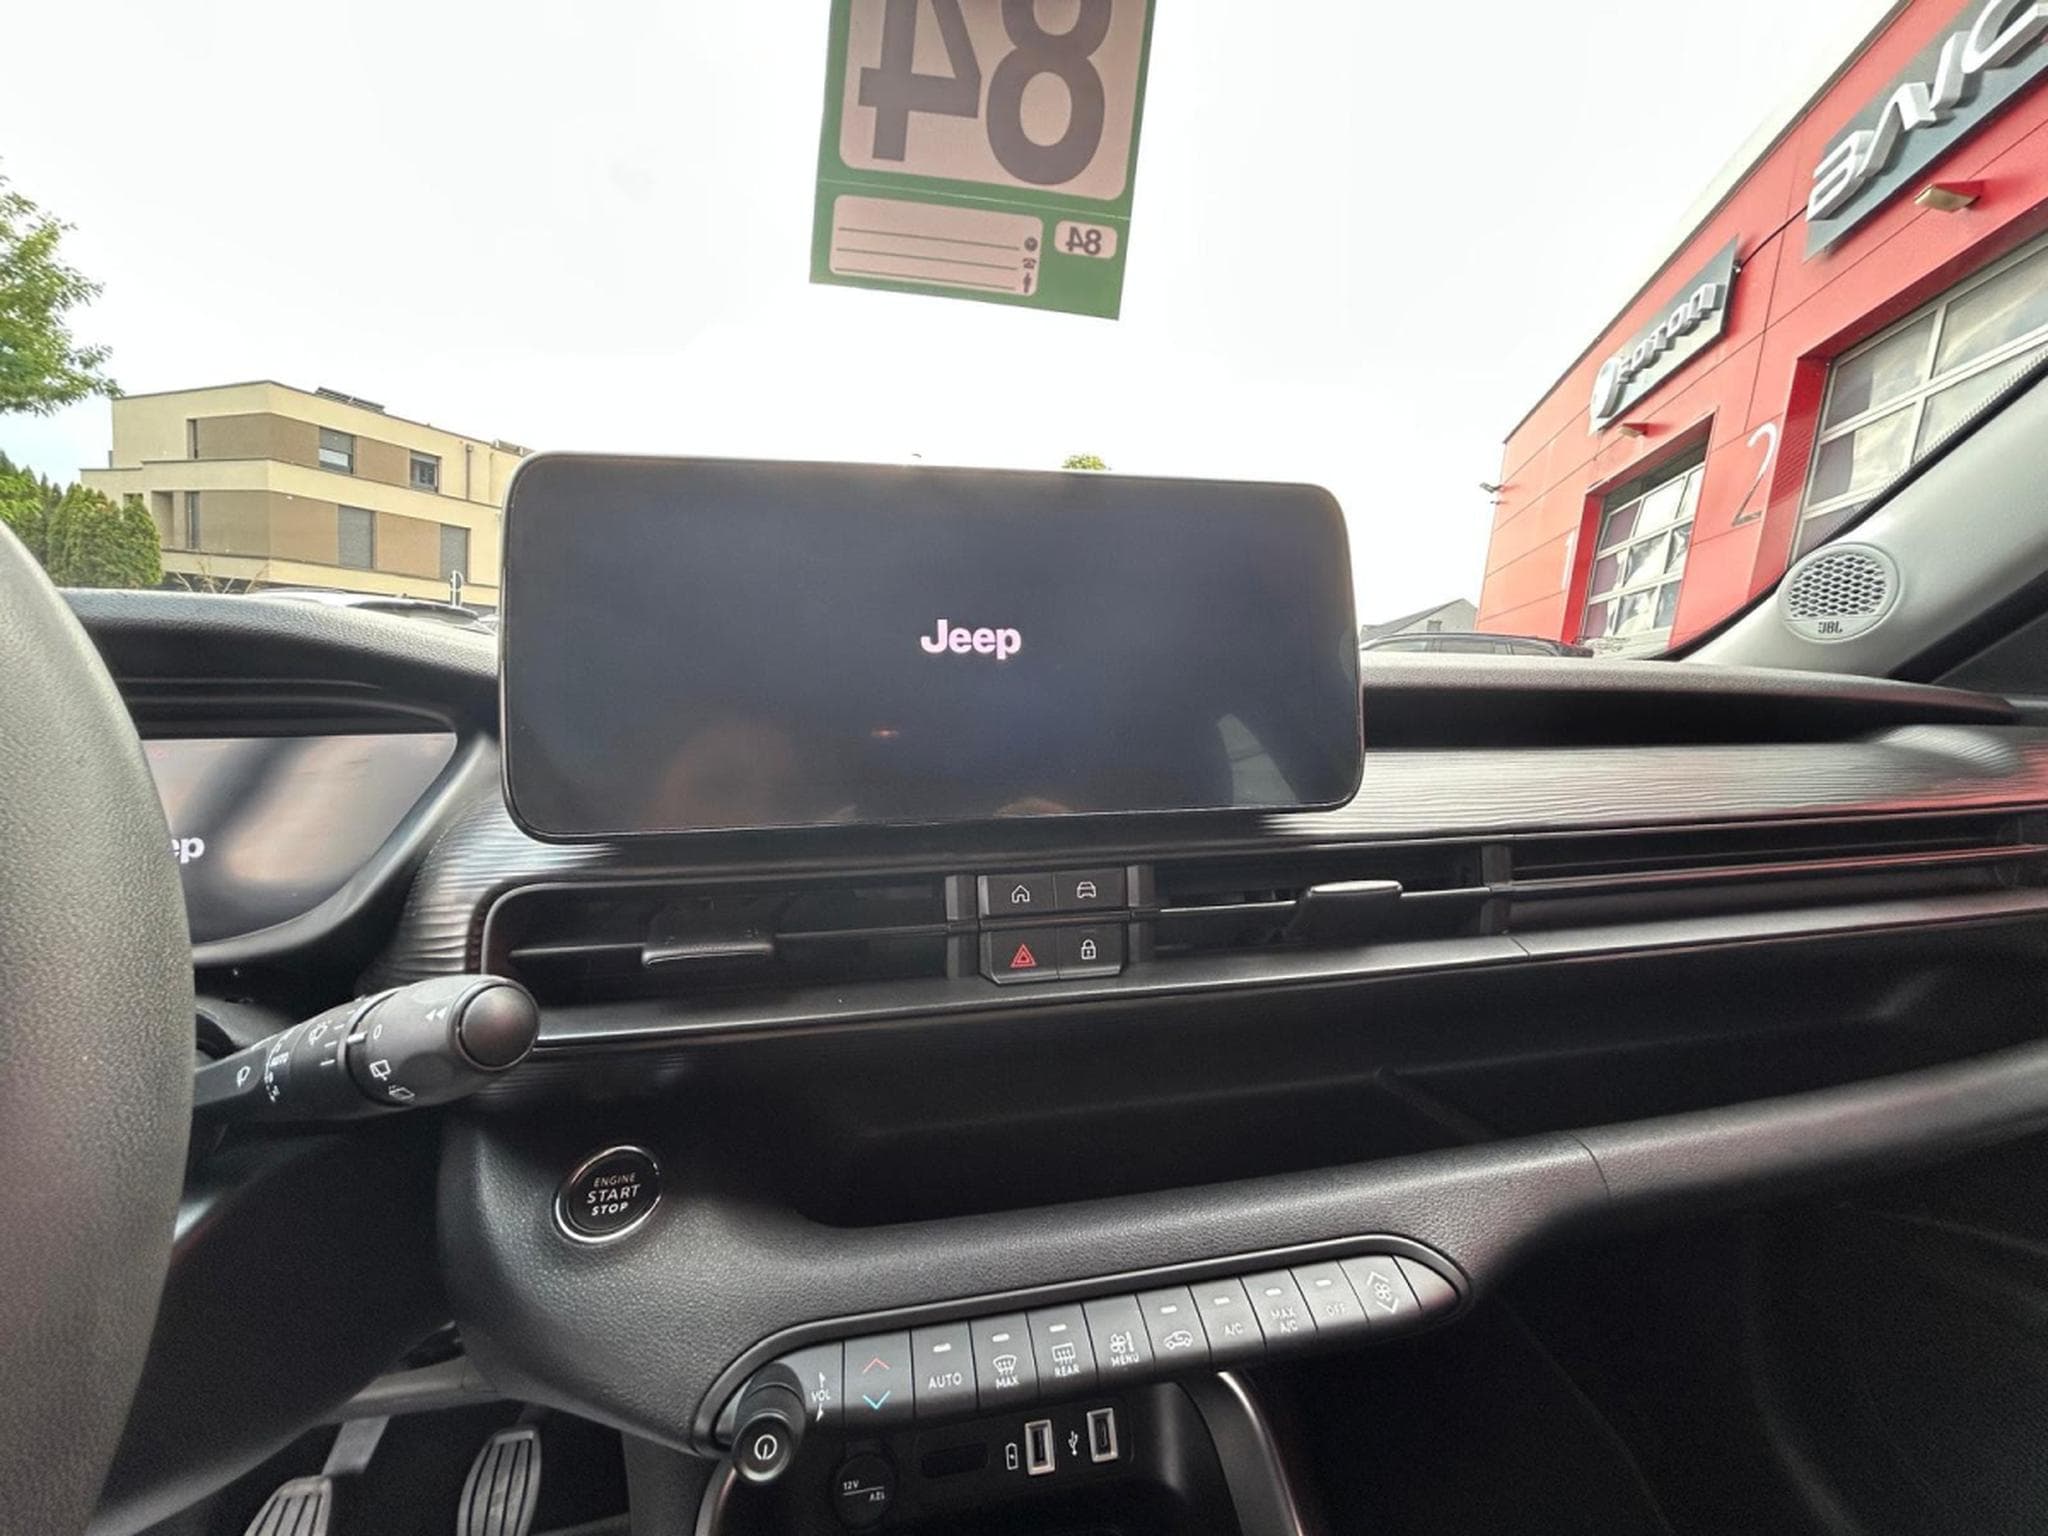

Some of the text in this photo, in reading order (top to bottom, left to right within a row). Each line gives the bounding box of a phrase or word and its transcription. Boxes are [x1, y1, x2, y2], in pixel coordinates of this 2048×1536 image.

[1731, 421, 1779, 527] 2
[1817, 620, 1843, 634] JBL
[920, 618, 1022, 661] Jeep
[593, 1171, 636, 1188] ENGINE
[586, 1183, 641, 1204] START
[591, 1201, 629, 1216] STOP
[1270, 1307, 1296, 1322] MAX
[1325, 1302, 1347, 1317] OFF
[1223, 1322, 1244, 1337] A/C
[1110, 1353, 1140, 1367] MENU
[1054, 1364, 1081, 1378] REAR
[928, 1371, 963, 1390] AUTO
[995, 1375, 1020, 1390] MAX
[810, 1389, 832, 1403] VOL
[842, 1479, 860, 1491] 12V
